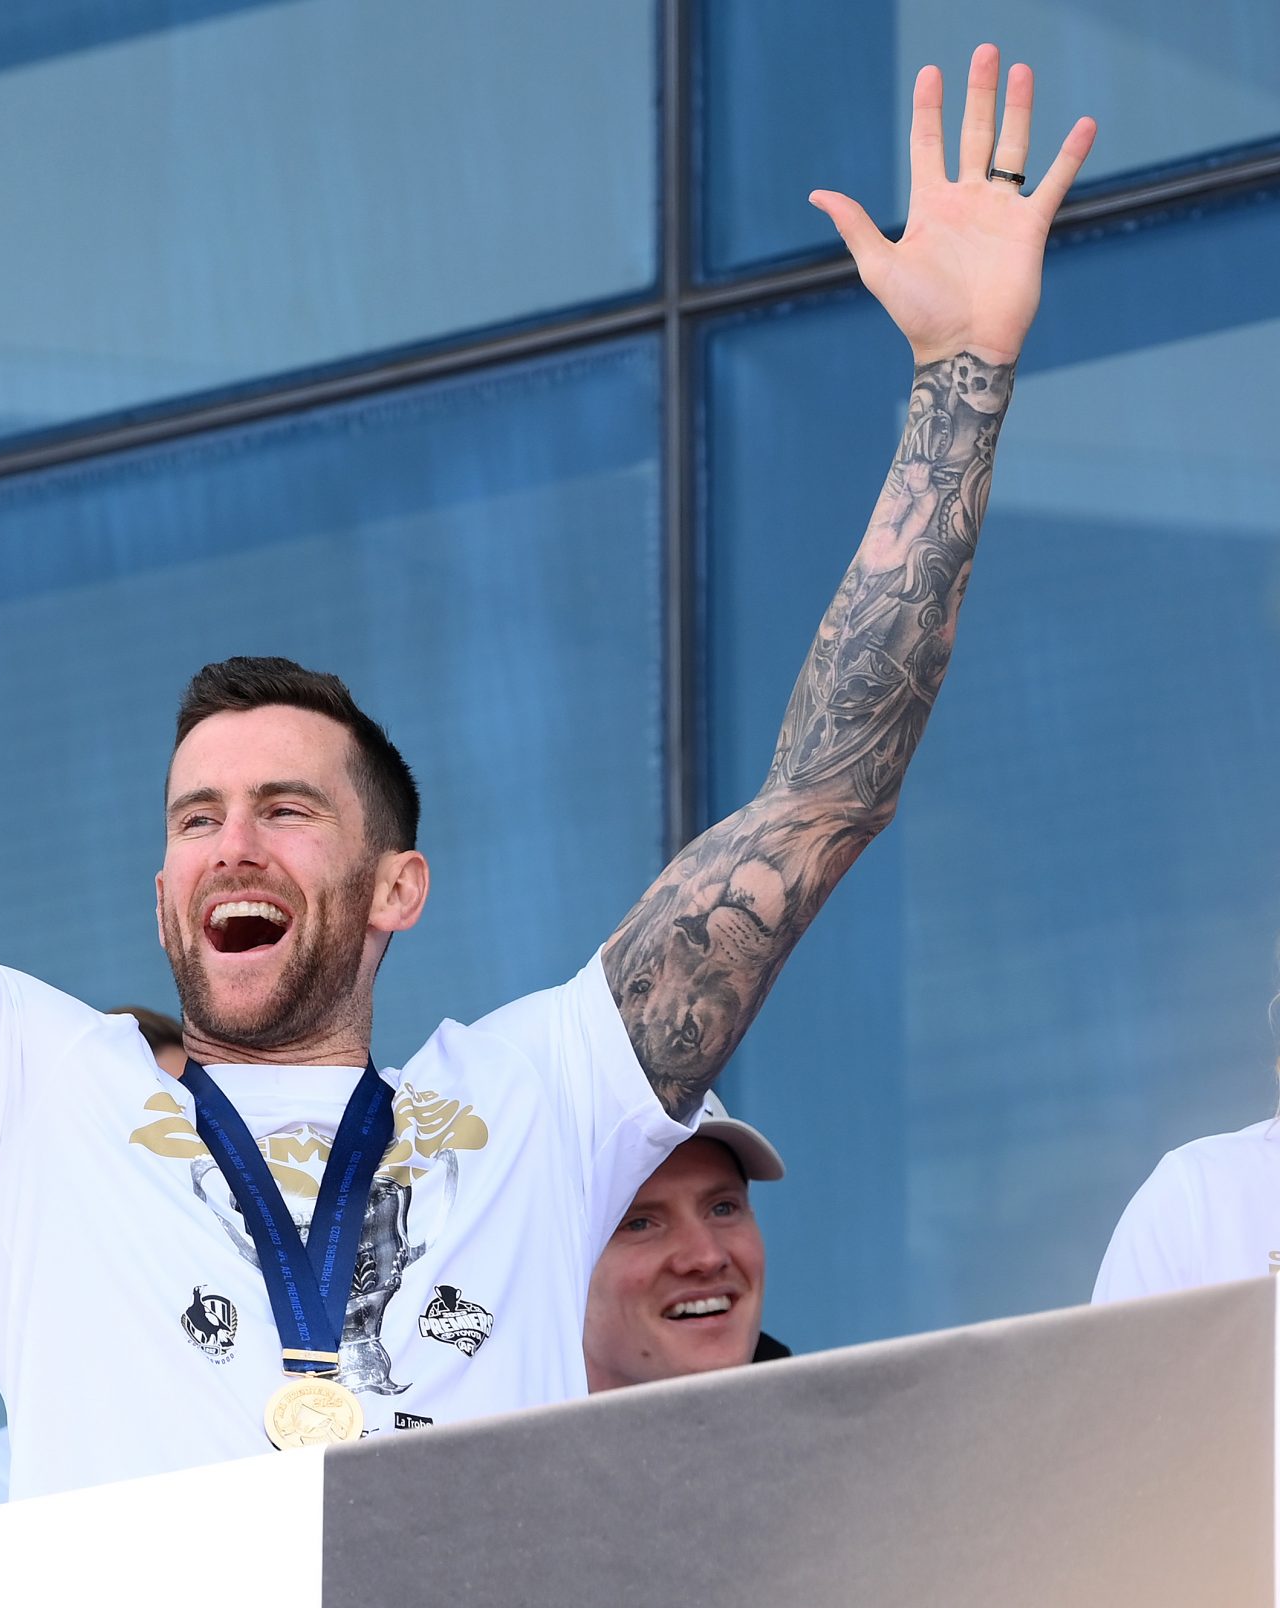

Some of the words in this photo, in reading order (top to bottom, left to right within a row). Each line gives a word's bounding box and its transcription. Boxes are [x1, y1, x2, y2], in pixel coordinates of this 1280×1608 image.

[268, 1227, 282, 1246] 2023
[328, 1225, 341, 1243] 2023
[281, 1265, 293, 1280] AFL
[321, 1244, 338, 1283] PREMIERS
[320, 1282, 330, 1298] AFL
[286, 1281, 305, 1321] PREMIERS
[297, 1322, 311, 1342] 2023
[419, 1312, 494, 1338] PREMIERS
[396, 1415, 406, 1427] La
